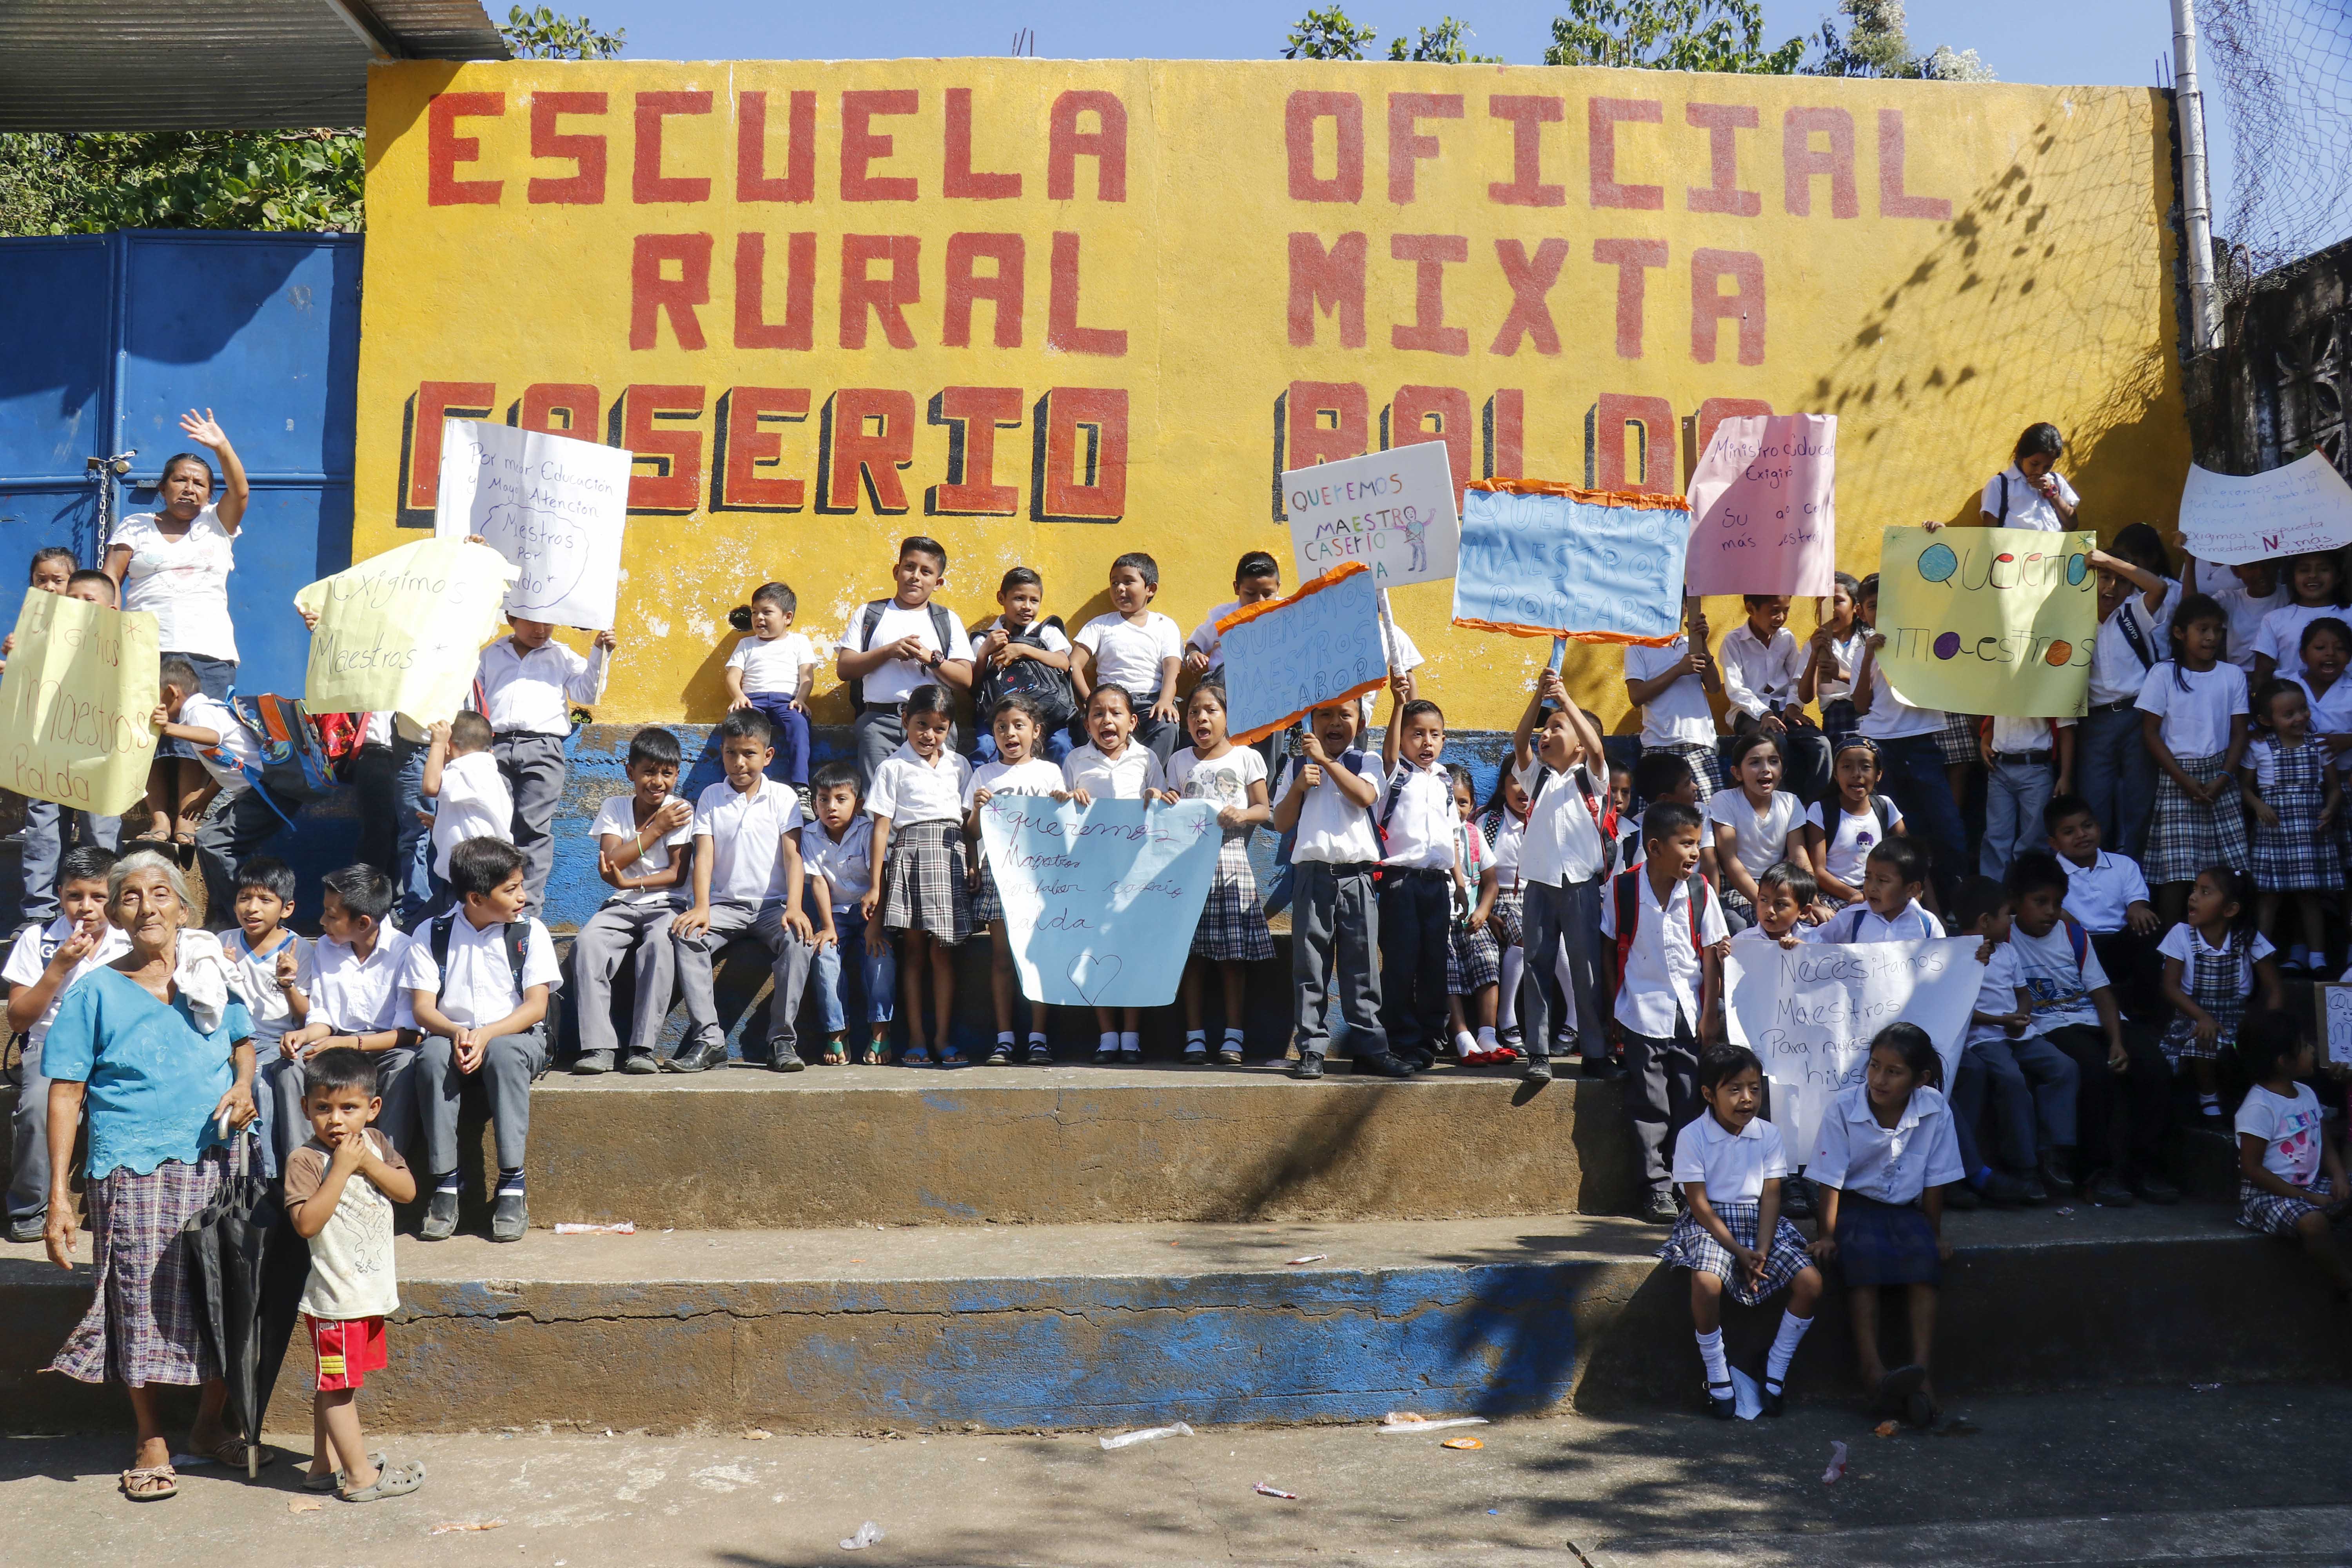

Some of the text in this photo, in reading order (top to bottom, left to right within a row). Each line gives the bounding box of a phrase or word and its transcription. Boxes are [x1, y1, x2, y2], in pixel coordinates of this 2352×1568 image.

[428, 87, 1952, 220] ESCUELA OFICIAL
[629, 231, 1764, 367] RURAL MIXTA
[1711, 436, 1778, 462] Ministro
[469, 442, 497, 466] Por
[541, 461, 614, 495] Educación
[529, 487, 599, 517] Atención
[1470, 493, 1683, 545] QUEREMOS
[2252, 516, 2323, 539] respuesta
[517, 546, 541, 560] Por
[1722, 532, 1756, 550] más
[2262, 534, 2289, 552] No
[2292, 533, 2332, 547] más
[1460, 537, 1673, 591] MAESTROS
[309, 632, 417, 676] Maestros
[1780, 951, 1944, 987] Necesitamos
[1777, 998, 1901, 1027] Maestros
[1760, 1029, 1811, 1058] Para
[1805, 1061, 1866, 1092] hijos
